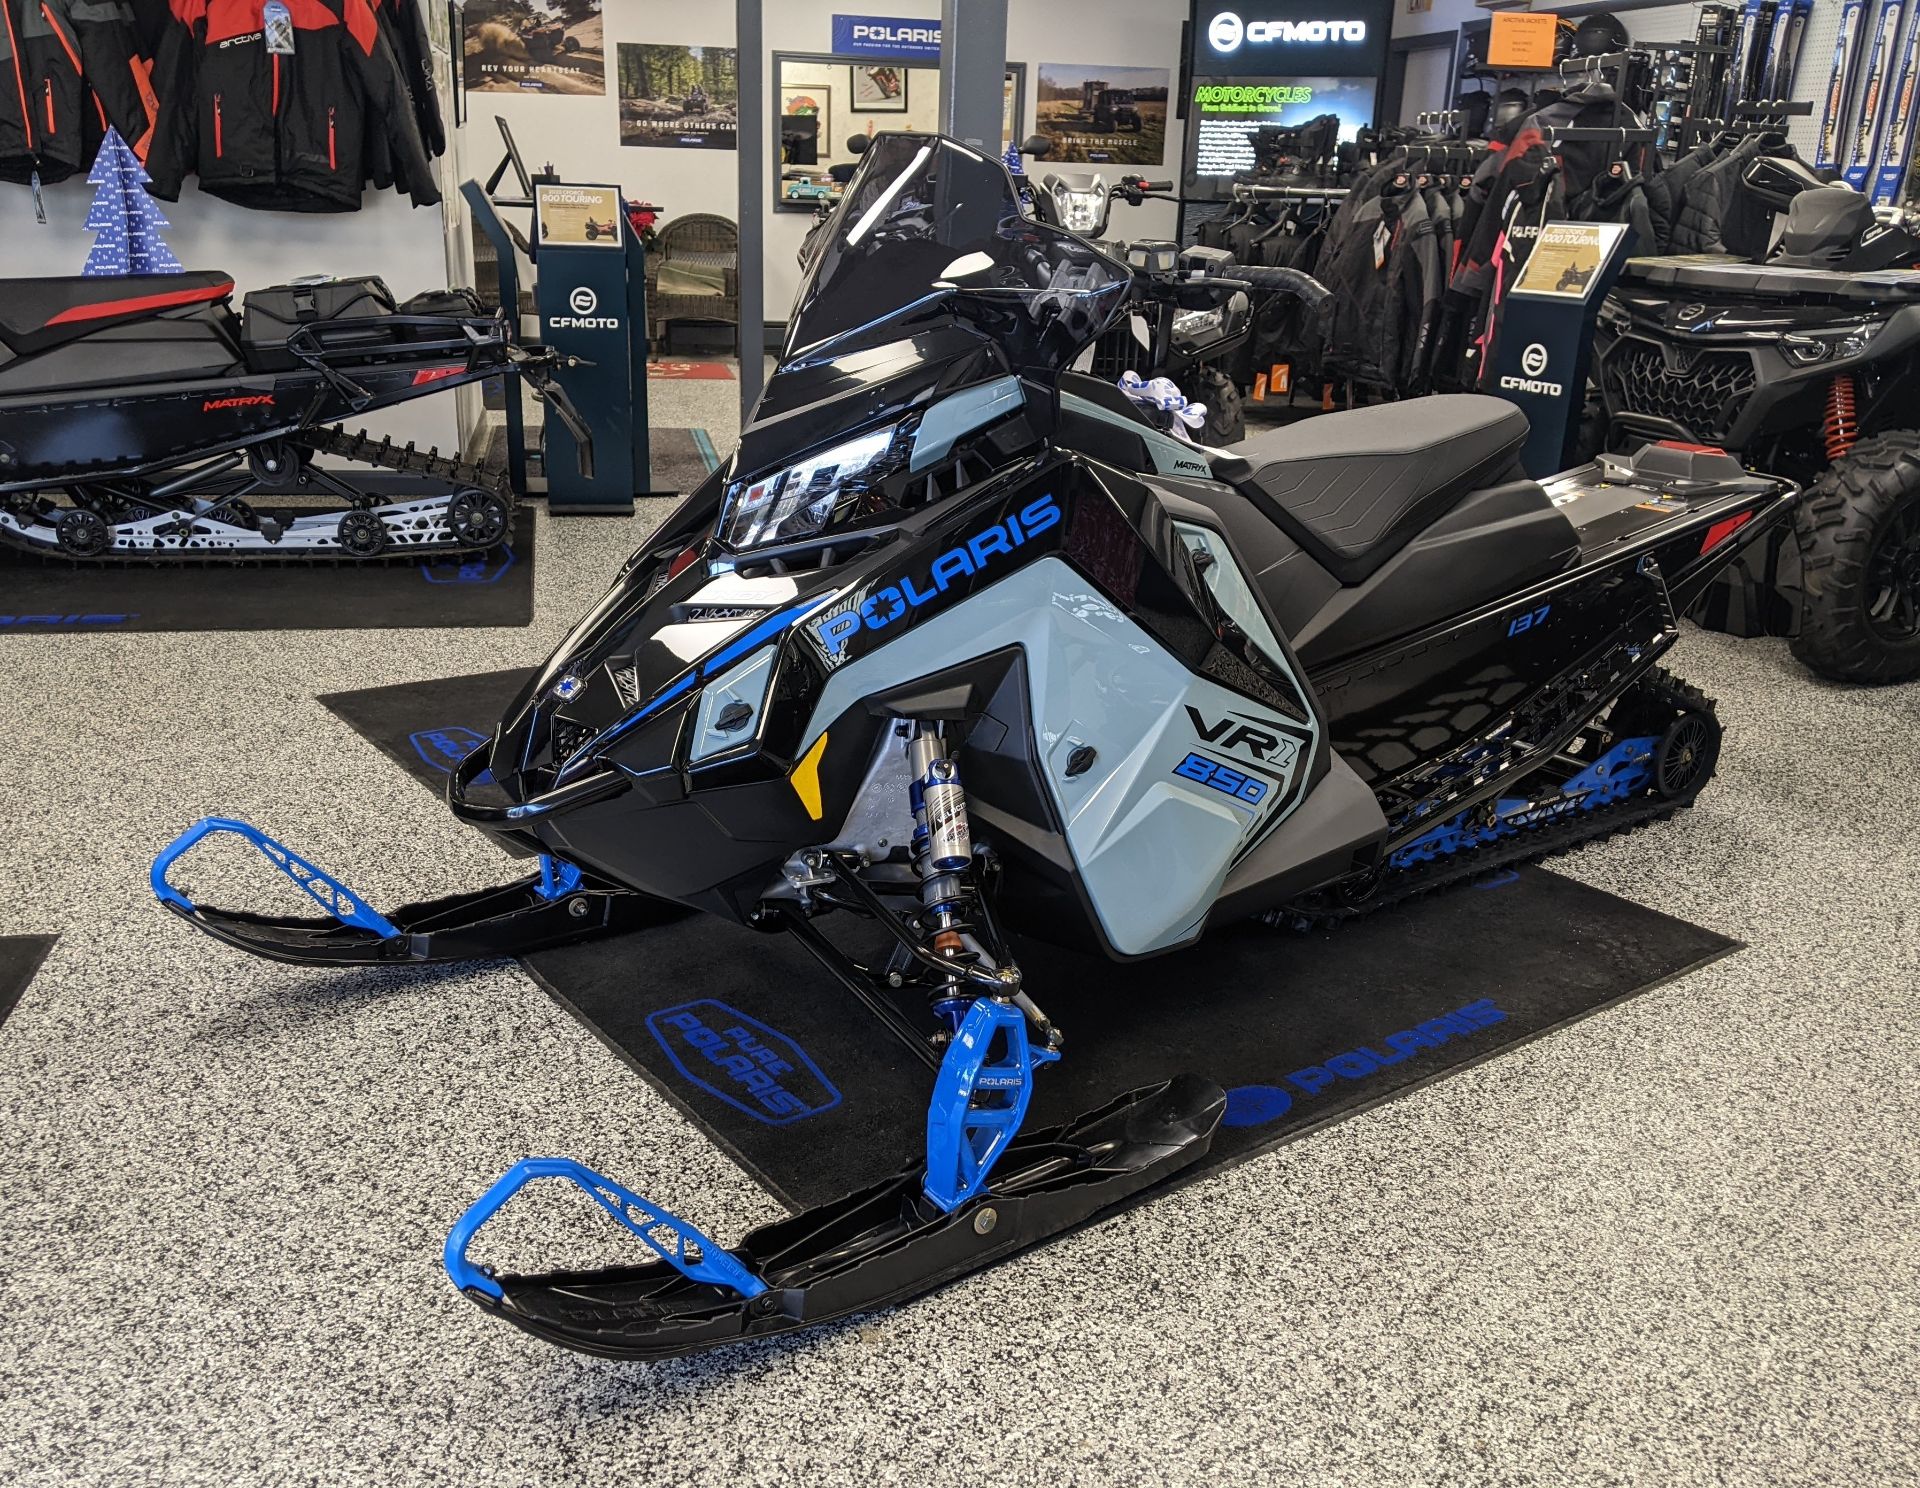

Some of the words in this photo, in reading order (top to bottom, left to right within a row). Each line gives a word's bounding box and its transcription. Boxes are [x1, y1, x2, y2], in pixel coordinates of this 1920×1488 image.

[219, 32, 262, 49] arctiva
[853, 25, 942, 43] POLARIS
[1246, 20, 1366, 43] CFMOTO
[481, 64, 499, 73] REV
[502, 65, 525, 73] YOUR
[529, 66, 580, 75] HEARTBEAT
[1195, 86, 1312, 104] MOTORCYCLES
[636, 120, 648, 128] GO
[651, 121, 680, 129] WHERE
[683, 122, 717, 130] OTHERS
[1062, 137, 1087, 145] BRING
[542, 194, 561, 203] 800
[561, 195, 603, 204] TOURING
[549, 316, 619, 329] CFMOTO
[1500, 376, 1562, 397] CFMOTO
[203, 394, 276, 412] MATRYX
[1173, 460, 1207, 476] MATRYX
[818, 493, 1062, 656] POLARIS
[1507, 605, 1550, 638] 137
[1184, 703, 1300, 769] VR1
[1172, 752, 1268, 806] 850
[937, 802, 967, 823] VELOCIT
[721, 1027, 794, 1077] PURE
[1286, 998, 1507, 1097] POLARIS
[664, 1013, 806, 1112] POLARIS
[978, 1075, 1023, 1087] POLARIS
